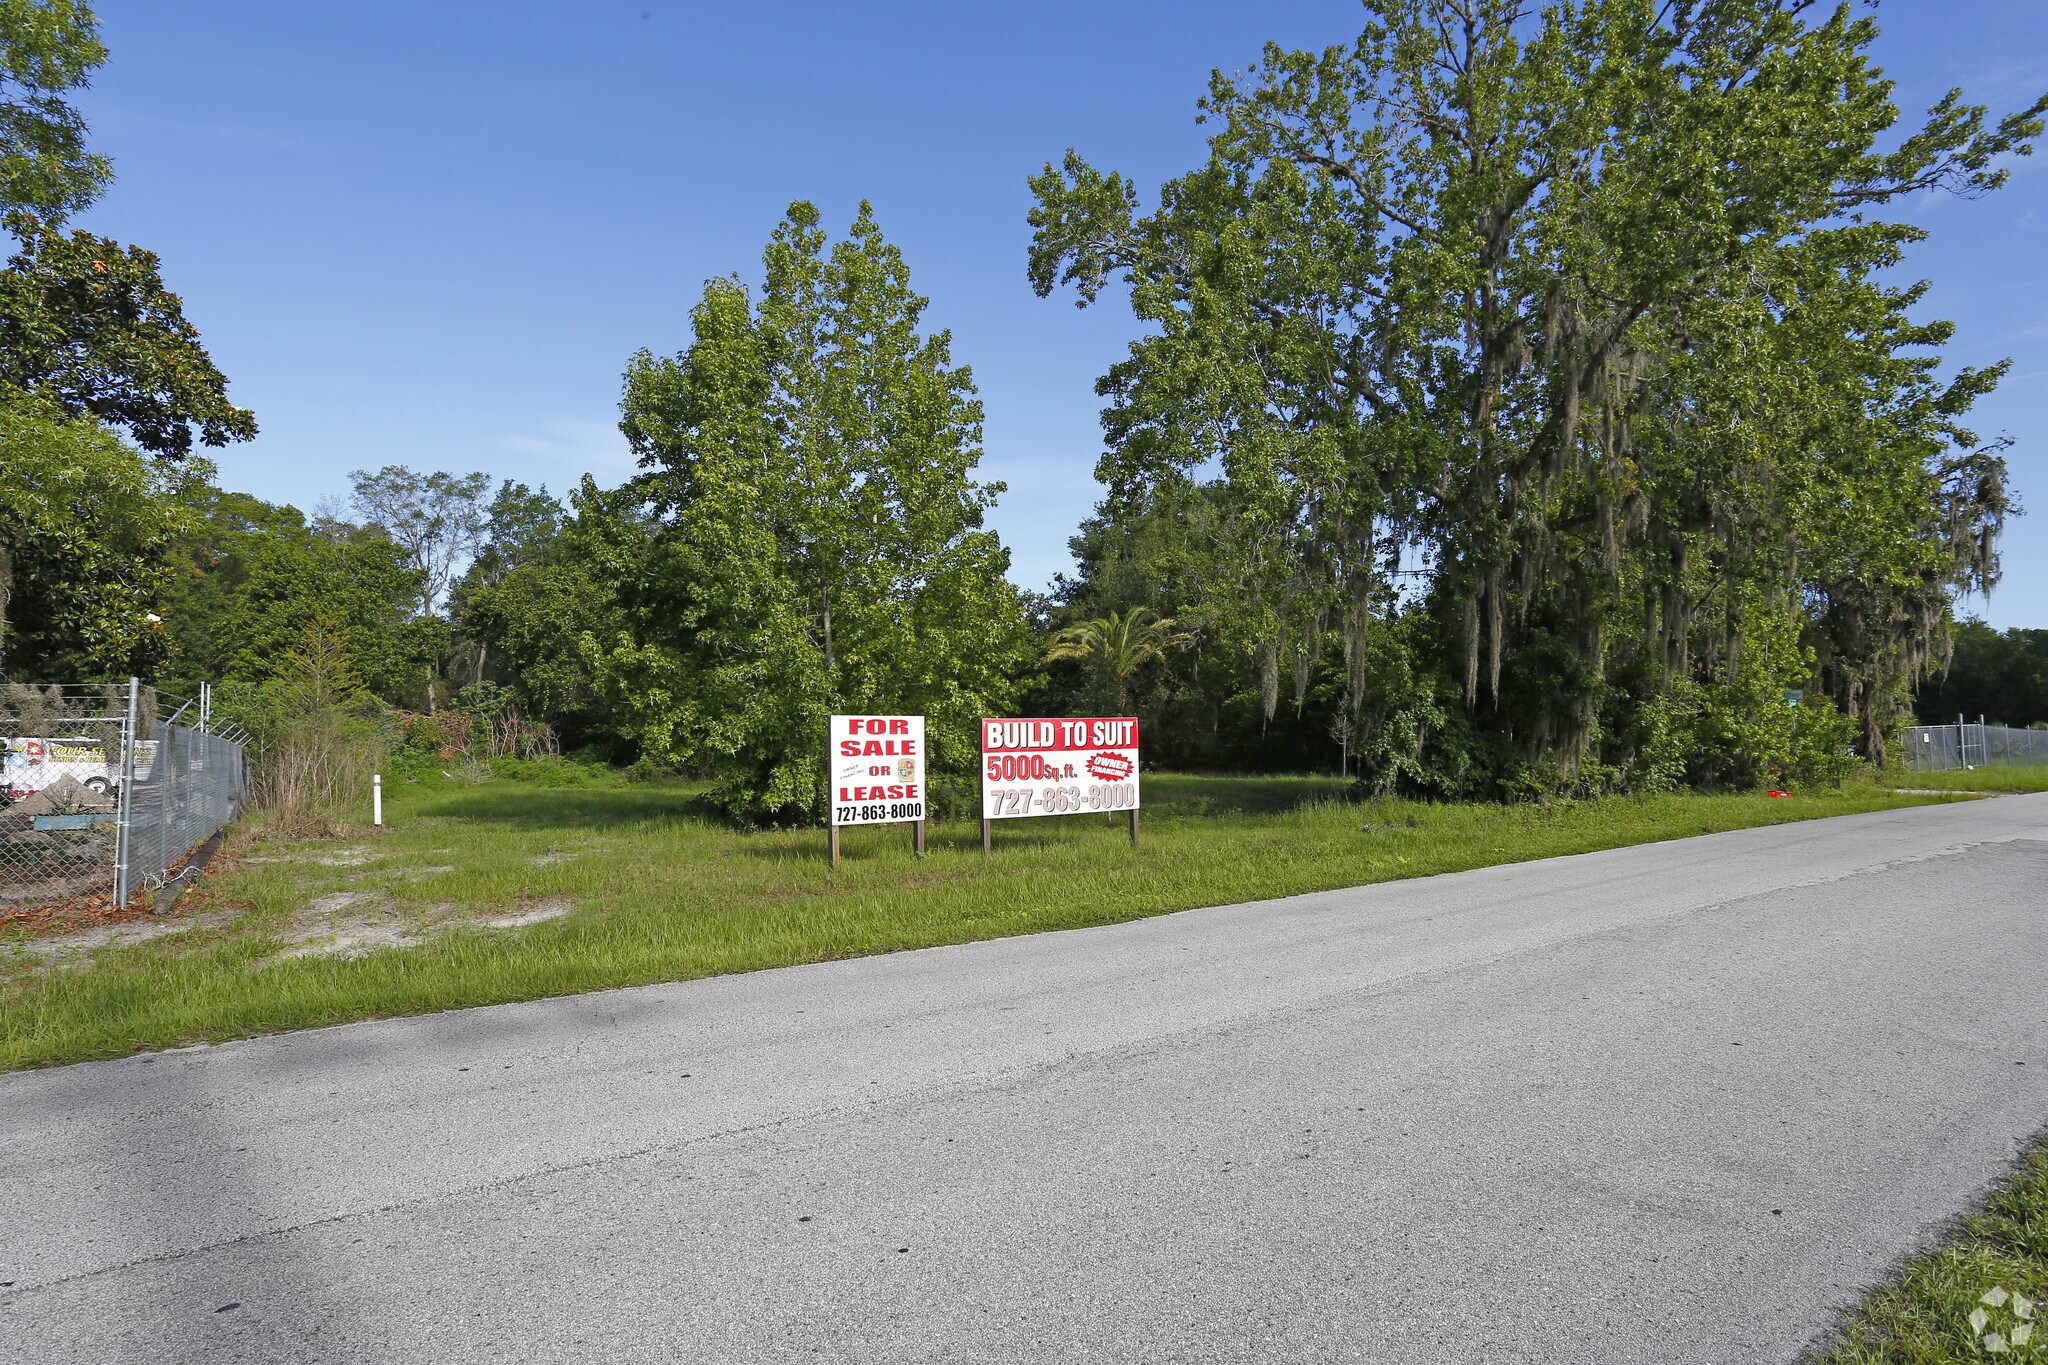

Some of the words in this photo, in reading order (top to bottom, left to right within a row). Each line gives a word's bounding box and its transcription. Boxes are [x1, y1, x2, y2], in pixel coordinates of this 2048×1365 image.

[848, 718, 909, 736] FOR
[986, 721, 1056, 749] BUILD
[1060, 721, 1088, 747] TO
[1092, 720, 1134, 746] SUIT
[840, 739, 916, 757] SALE
[868, 765, 891, 777] OR
[987, 754, 1044, 781] 5000
[1090, 765, 1126, 778] FINANCING
[1093, 756, 1129, 771] OWNER
[839, 784, 919, 802] LEASE
[990, 782, 1135, 816] 727-863-8000
[836, 802, 922, 822] 727-863-8000
